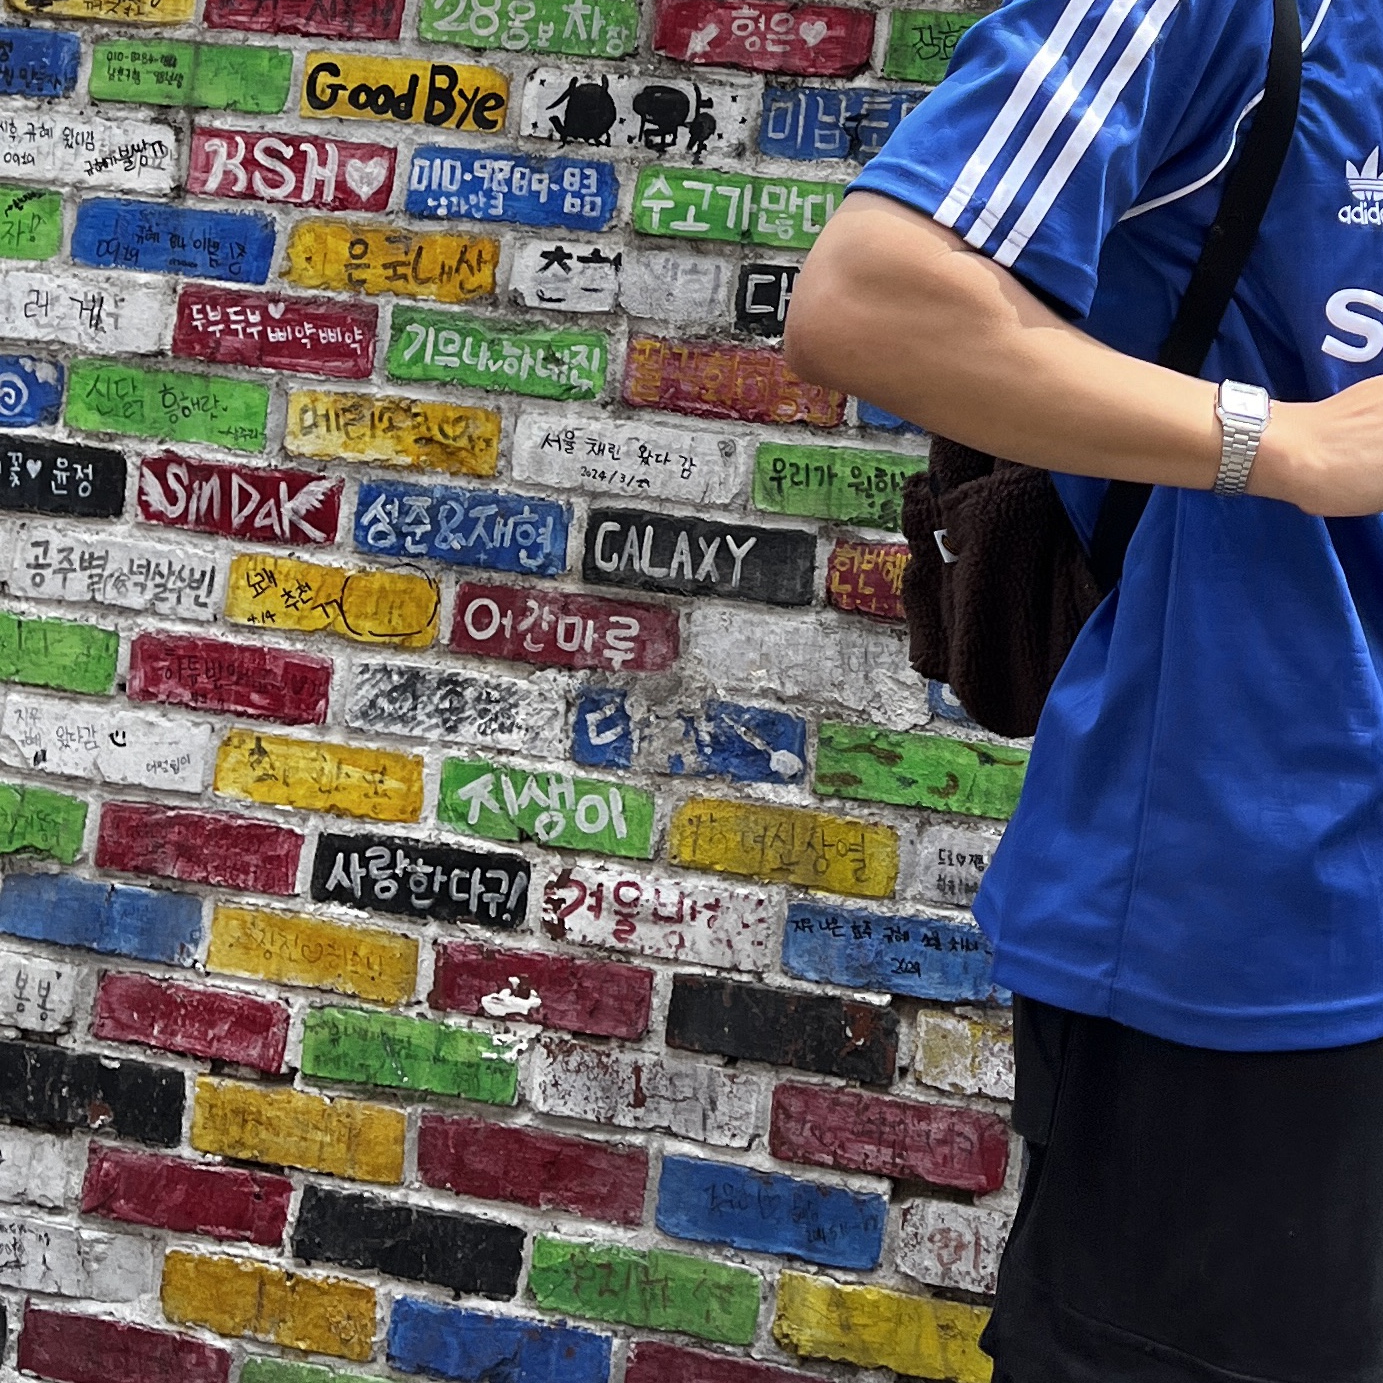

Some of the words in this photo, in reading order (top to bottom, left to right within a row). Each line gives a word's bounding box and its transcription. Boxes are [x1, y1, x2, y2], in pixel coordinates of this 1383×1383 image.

[203, 136, 337, 203] KSH
[190, 303, 262, 341] 두부두부
[266, 323, 364, 351] 삐약삐약
[541, 431, 576, 455] 서울
[585, 437, 622, 462] 채린
[51, 457, 94, 498] 윤정
[769, 457, 839, 494] 우리가
[595, 520, 758, 589] GALAXY
[325, 845, 528, 929] 사랑한다구!
